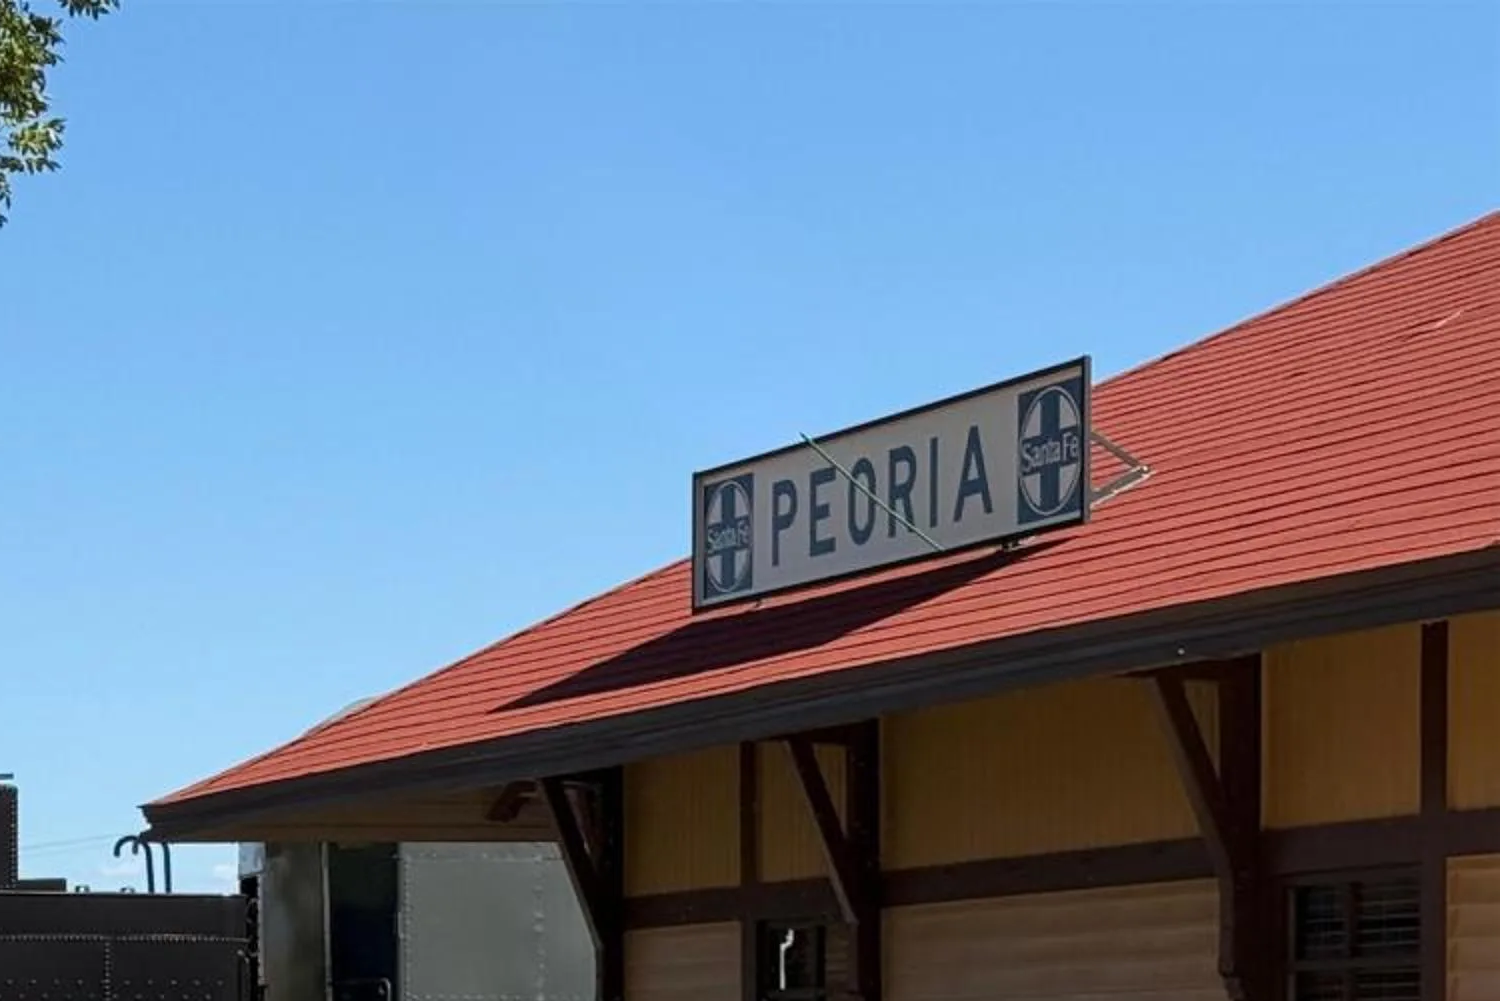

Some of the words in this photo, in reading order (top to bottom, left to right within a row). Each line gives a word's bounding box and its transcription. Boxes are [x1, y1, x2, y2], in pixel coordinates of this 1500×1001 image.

[1022, 438, 1060, 472] Santa
[1063, 431, 1078, 461] Fe
[771, 425, 993, 567] PEORIA
[707, 527, 735, 553] Santa
